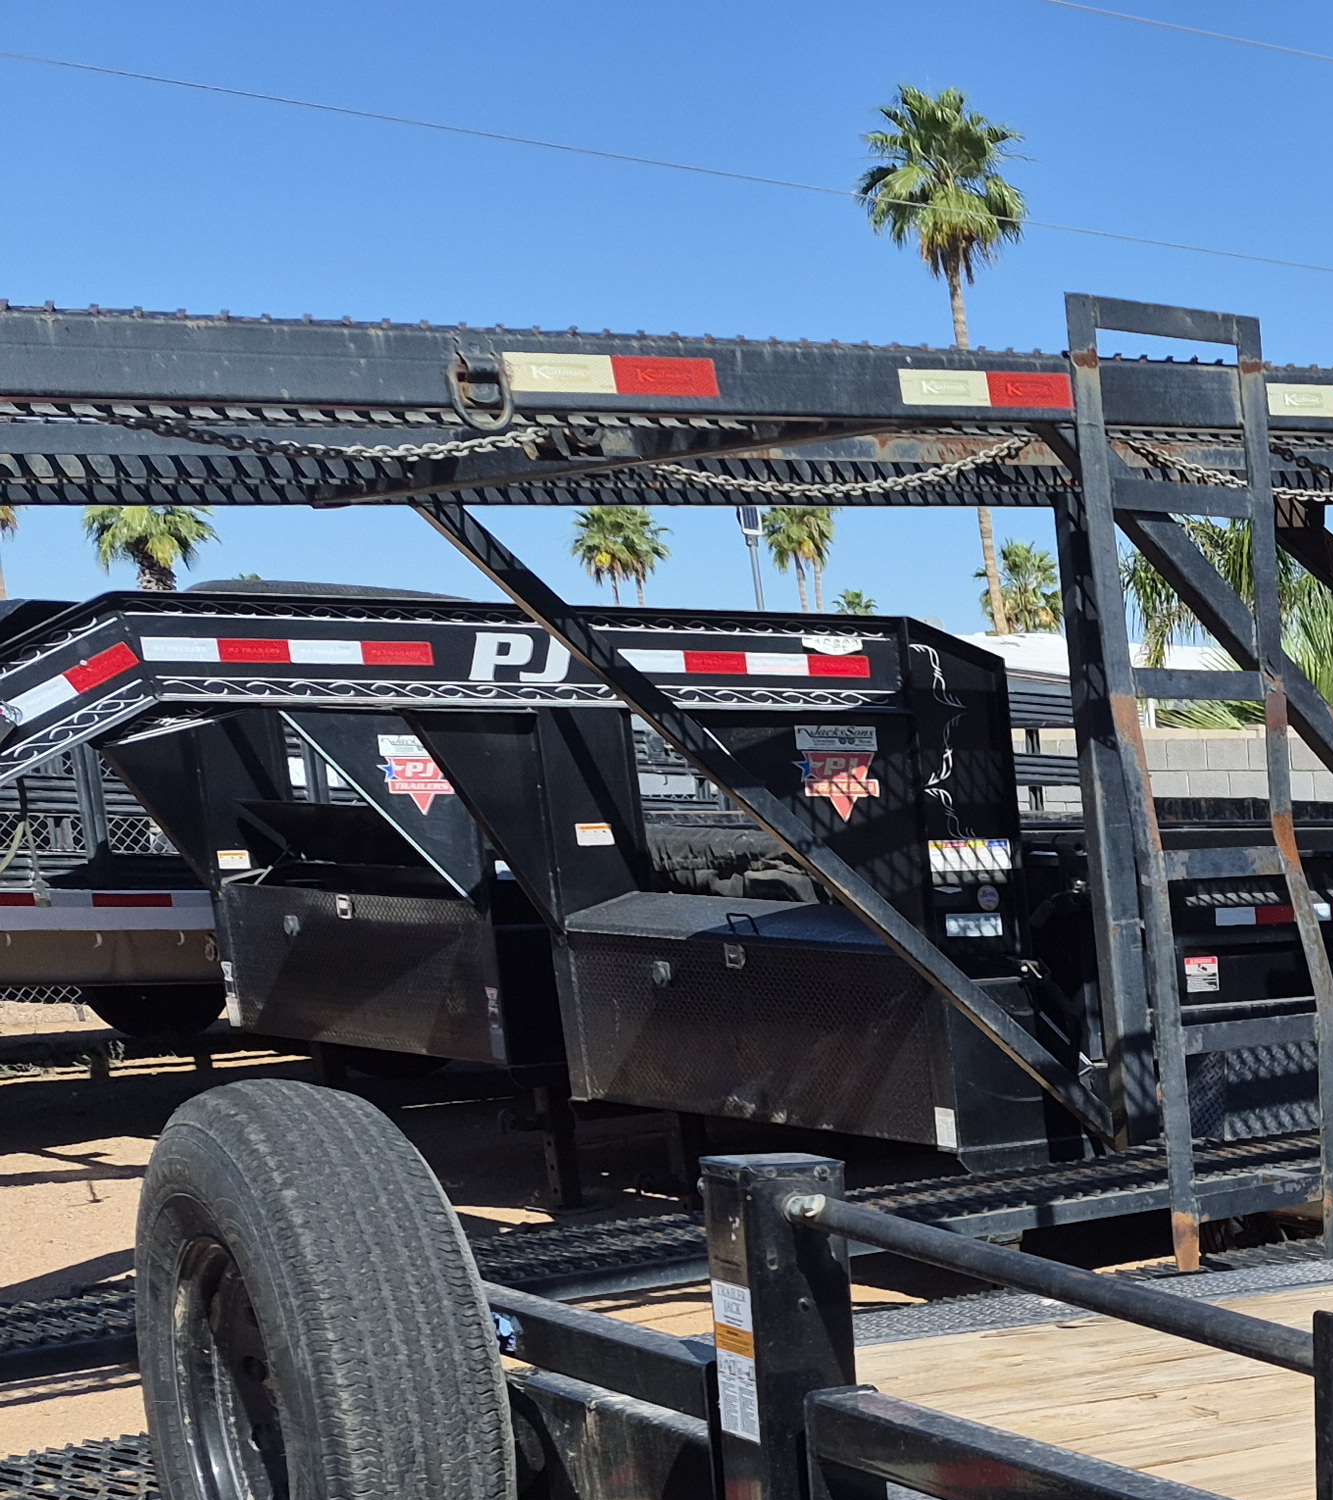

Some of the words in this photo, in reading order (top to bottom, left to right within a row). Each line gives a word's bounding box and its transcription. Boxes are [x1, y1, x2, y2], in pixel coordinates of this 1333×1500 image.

[469, 632, 572, 683] PJ
[404, 762, 435, 777] PJ
[394, 782, 449, 790] TRAILERS
[716, 1283, 746, 1302] TRAILER
